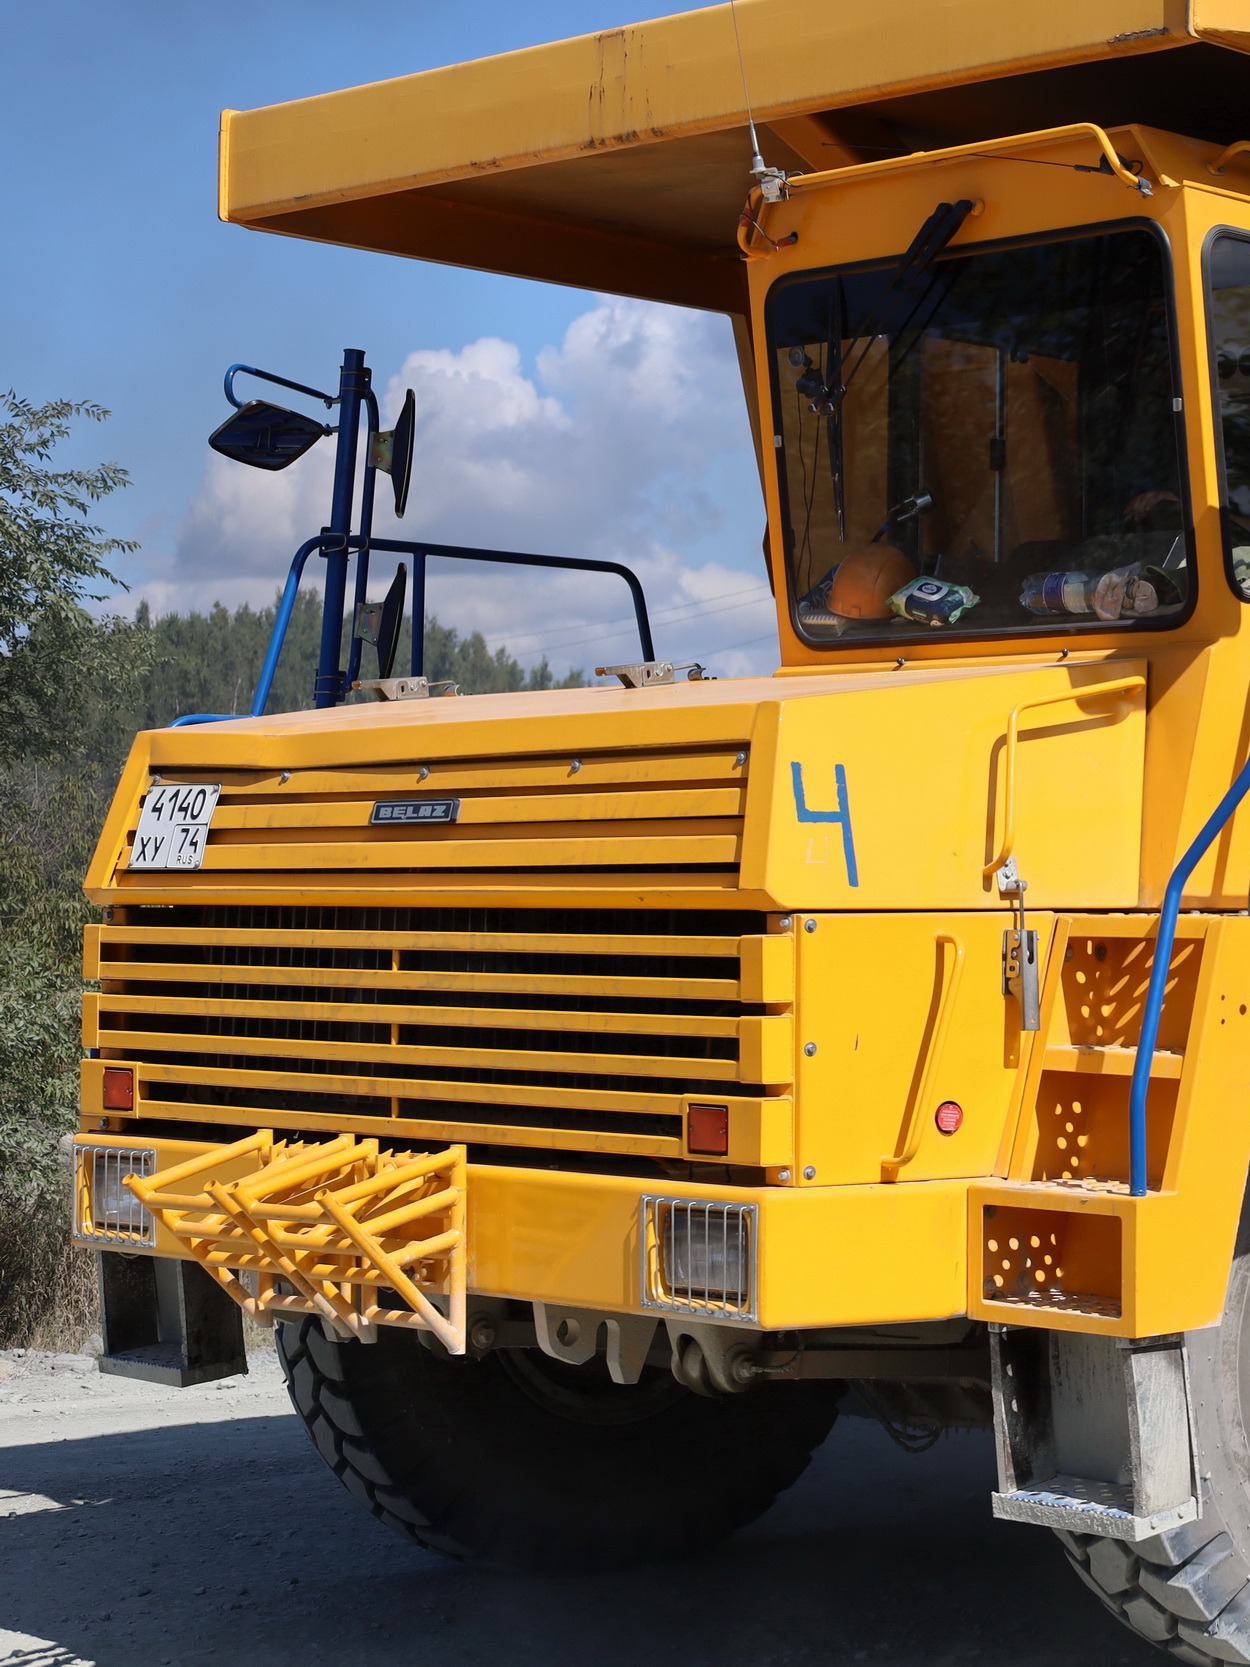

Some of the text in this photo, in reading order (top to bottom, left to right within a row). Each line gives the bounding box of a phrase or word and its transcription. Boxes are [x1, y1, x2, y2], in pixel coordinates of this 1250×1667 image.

[151, 788, 207, 821] 4140
[379, 805, 447, 818] BELAZ
[791, 761, 859, 888] 4
[178, 828, 200, 854] 74
[176, 855, 193, 865] RUS
